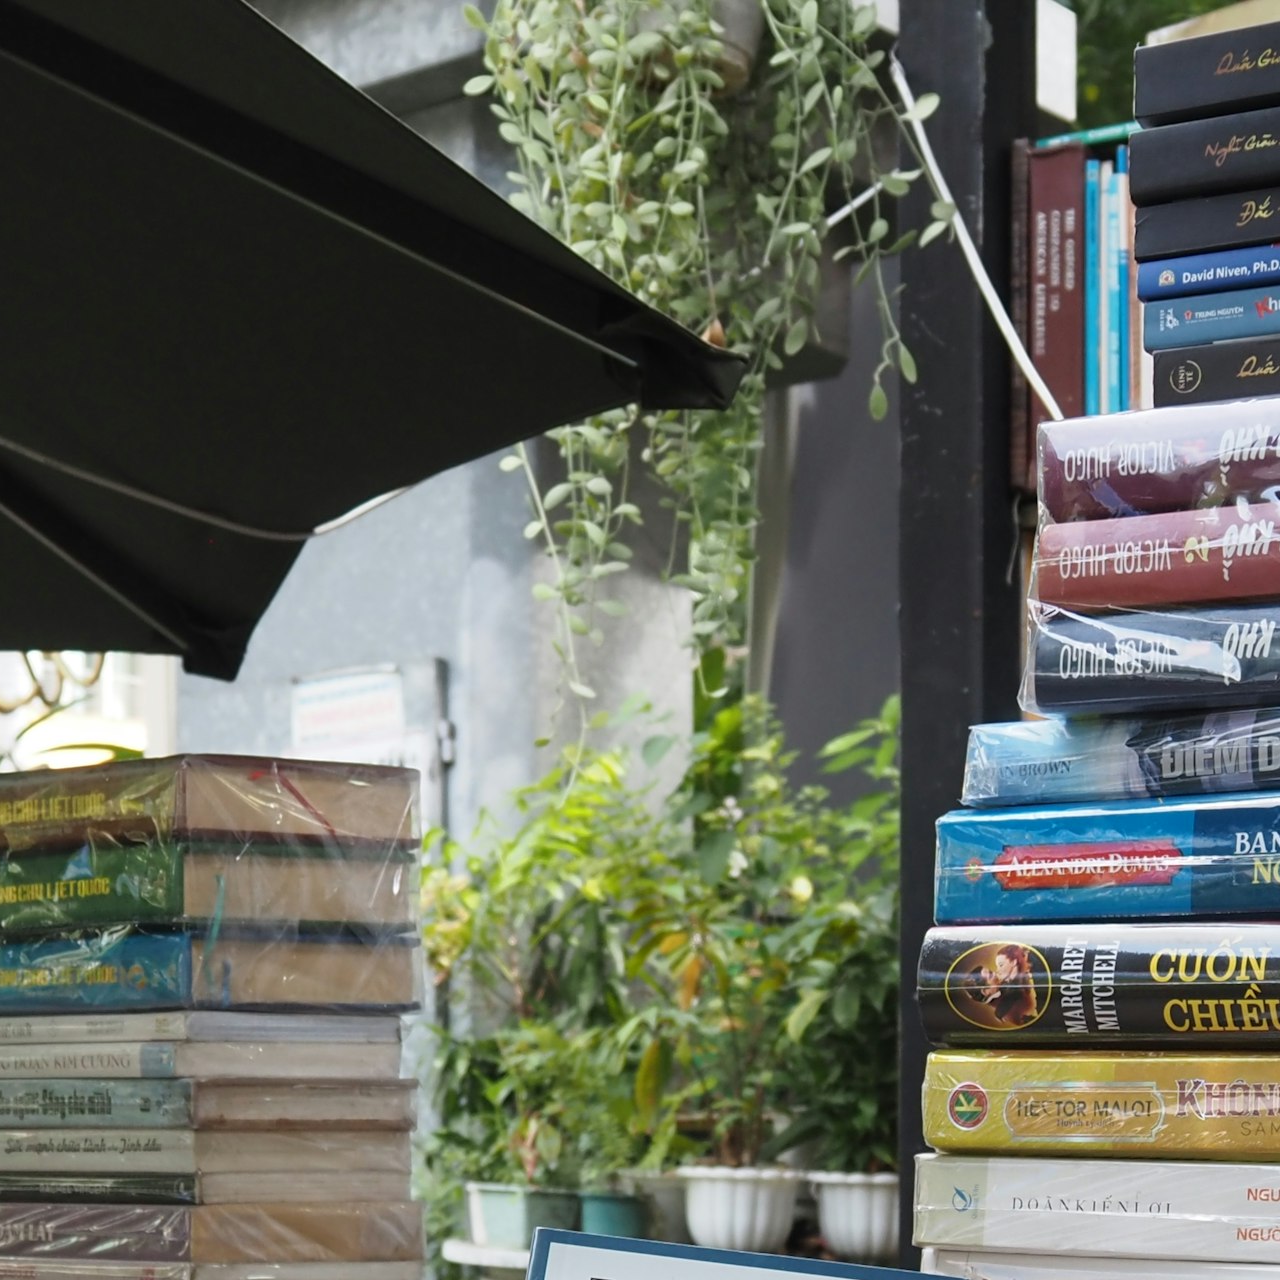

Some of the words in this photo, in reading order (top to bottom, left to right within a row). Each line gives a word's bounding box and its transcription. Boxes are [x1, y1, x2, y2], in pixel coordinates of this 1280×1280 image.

[1182, 269, 1214, 284] David
[1215, 264, 1252, 282] Niven,
[1064, 445, 1113, 482] HUGO
[1117, 438, 1176, 472] VICTOR
[1058, 543, 1109, 580] HUGO
[1113, 537, 1172, 575] VICTOR
[1234, 831, 1267, 855] BA
[1067, 936, 1090, 1036] MARGARET
